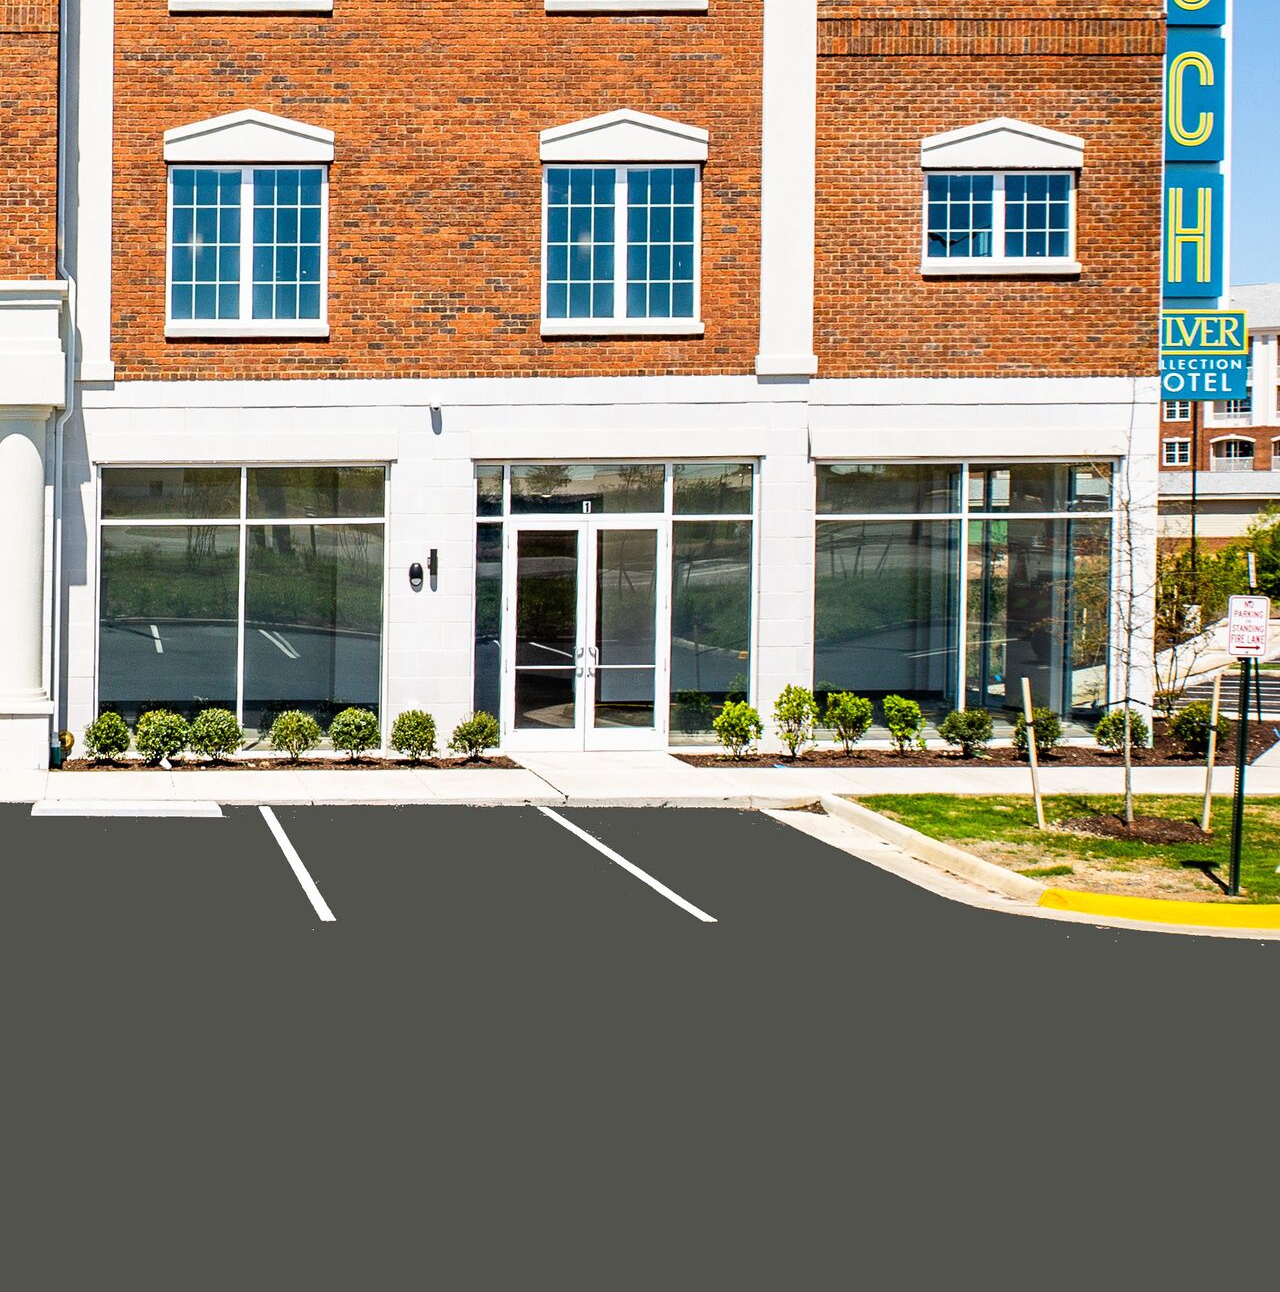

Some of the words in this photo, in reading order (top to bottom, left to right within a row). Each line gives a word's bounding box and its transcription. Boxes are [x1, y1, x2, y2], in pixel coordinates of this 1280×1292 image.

[1162, 317, 1242, 347] LVER
[1161, 359, 1242, 370] LLECTION
[1163, 372, 1233, 392] OTEL
[1244, 600, 1255, 608] NO
[1234, 610, 1264, 618] PARKING
[1232, 624, 1265, 633] STANDING
[1231, 634, 1245, 644] FIRE
[1247, 634, 1265, 645] LANE
